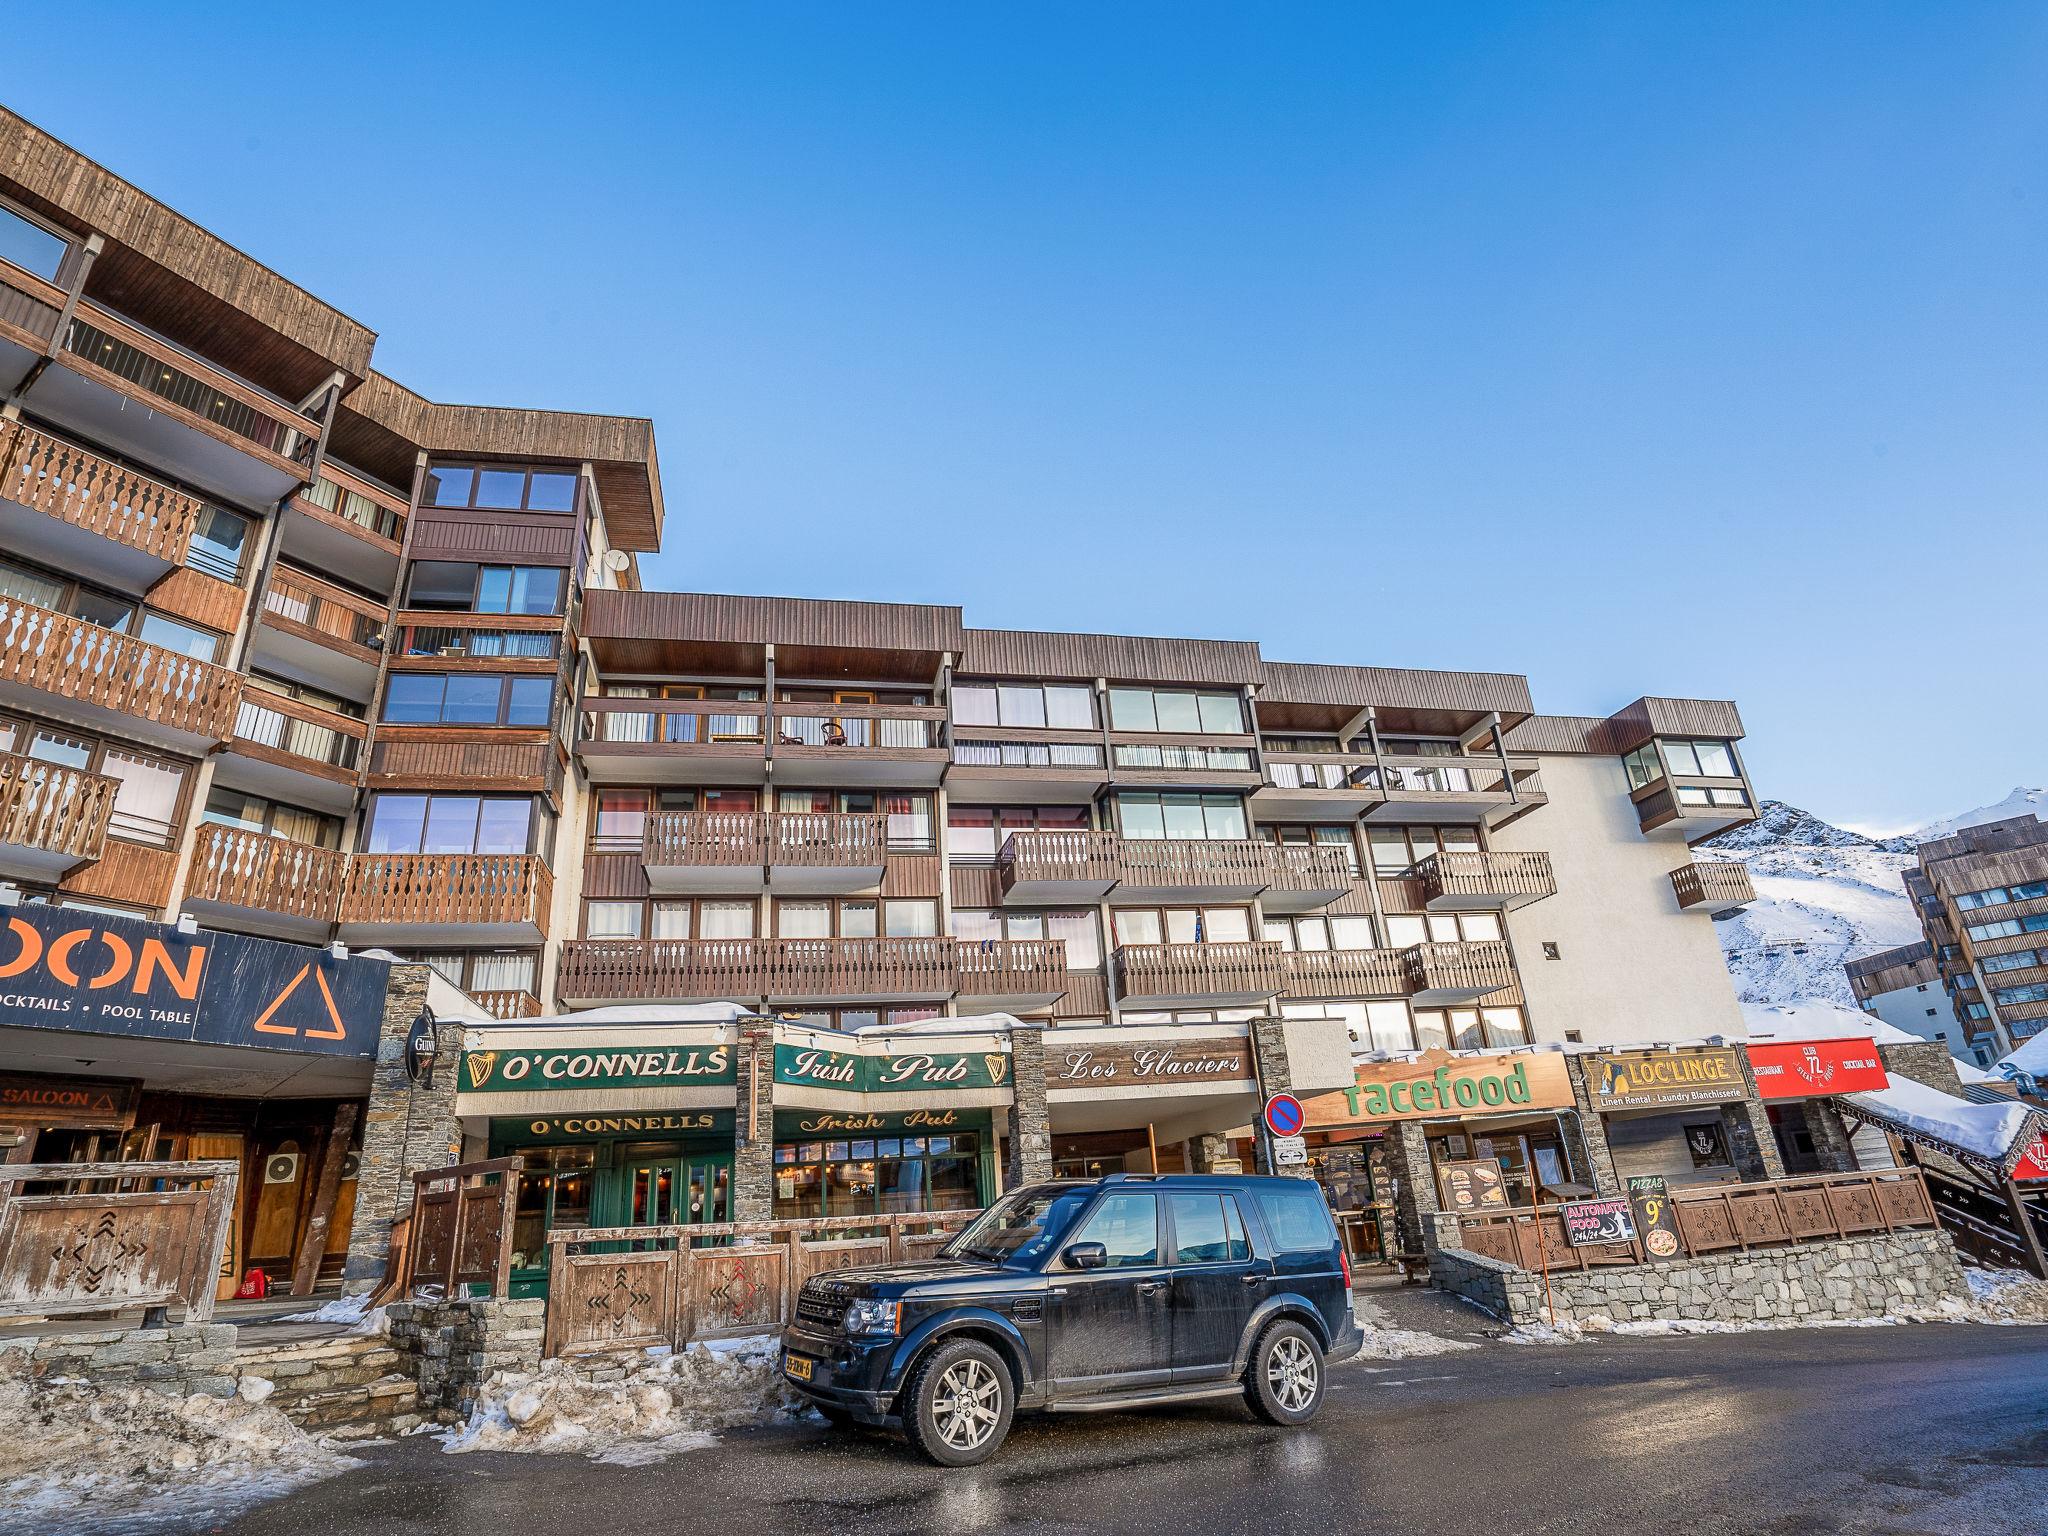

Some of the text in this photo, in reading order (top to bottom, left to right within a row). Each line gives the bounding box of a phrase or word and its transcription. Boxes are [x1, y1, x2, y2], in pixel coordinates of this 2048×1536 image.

[0, 994, 192, 1024] CKTAILS POOL TABLE
[502, 1051, 729, 1081] O'CONNELLS
[784, 1051, 968, 1083] Irish Pub
[1059, 1050, 1240, 1079] Les Glaciers
[1628, 1057, 1731, 1086] LOC'LINGE
[1753, 1065, 1785, 1076] RESTAURANT
[1806, 1056, 1823, 1075] 72
[1866, 1059, 1877, 1068] BAR
[1796, 1066, 1814, 1083] STEAK
[3, 1088, 89, 1105] SALOON
[1600, 1098, 1624, 1107] Linen
[1625, 1094, 1651, 1105] Rental
[1657, 1092, 1690, 1104] Laundry
[530, 1114, 715, 1135] O'CONNELLS
[800, 1109, 958, 1132] Irish Pub
[1630, 1177, 1663, 1191] PIZZAS
[1567, 1202, 1629, 1218] AUTOMATIC
[1570, 1218, 1600, 1230] FOOD
